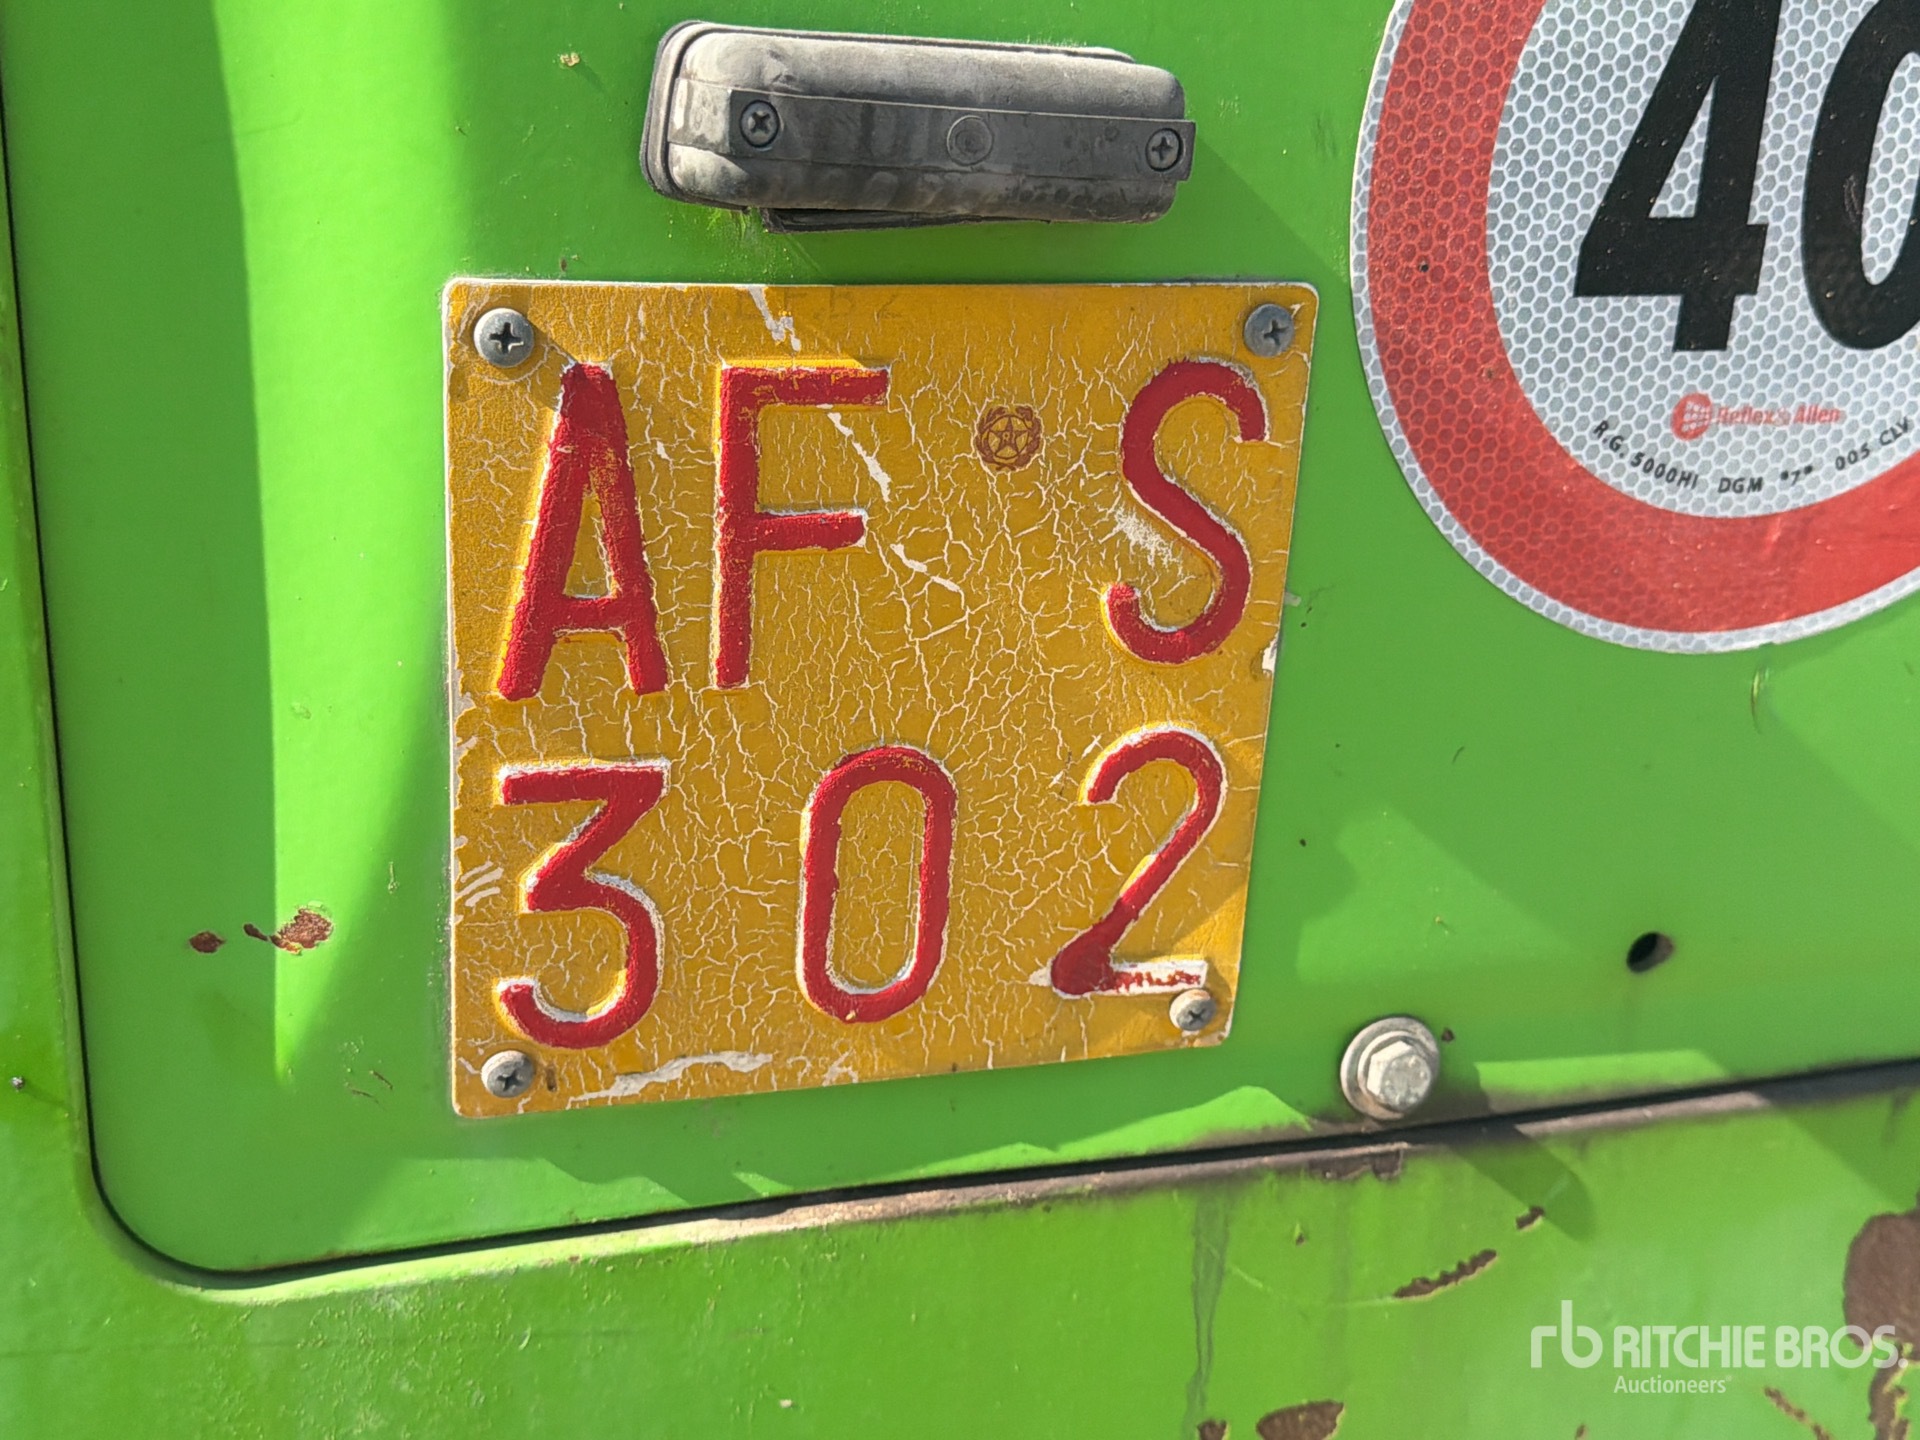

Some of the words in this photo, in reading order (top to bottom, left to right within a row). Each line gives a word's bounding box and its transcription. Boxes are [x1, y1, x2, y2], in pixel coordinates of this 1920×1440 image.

[1575, 0, 1920, 352] 40
[495, 360, 892, 702] AF
[1100, 356, 1268, 666] S
[1593, 420, 1625, 458] R.G.
[1717, 476, 1764, 494] DGM
[1835, 442, 1870, 471] 005
